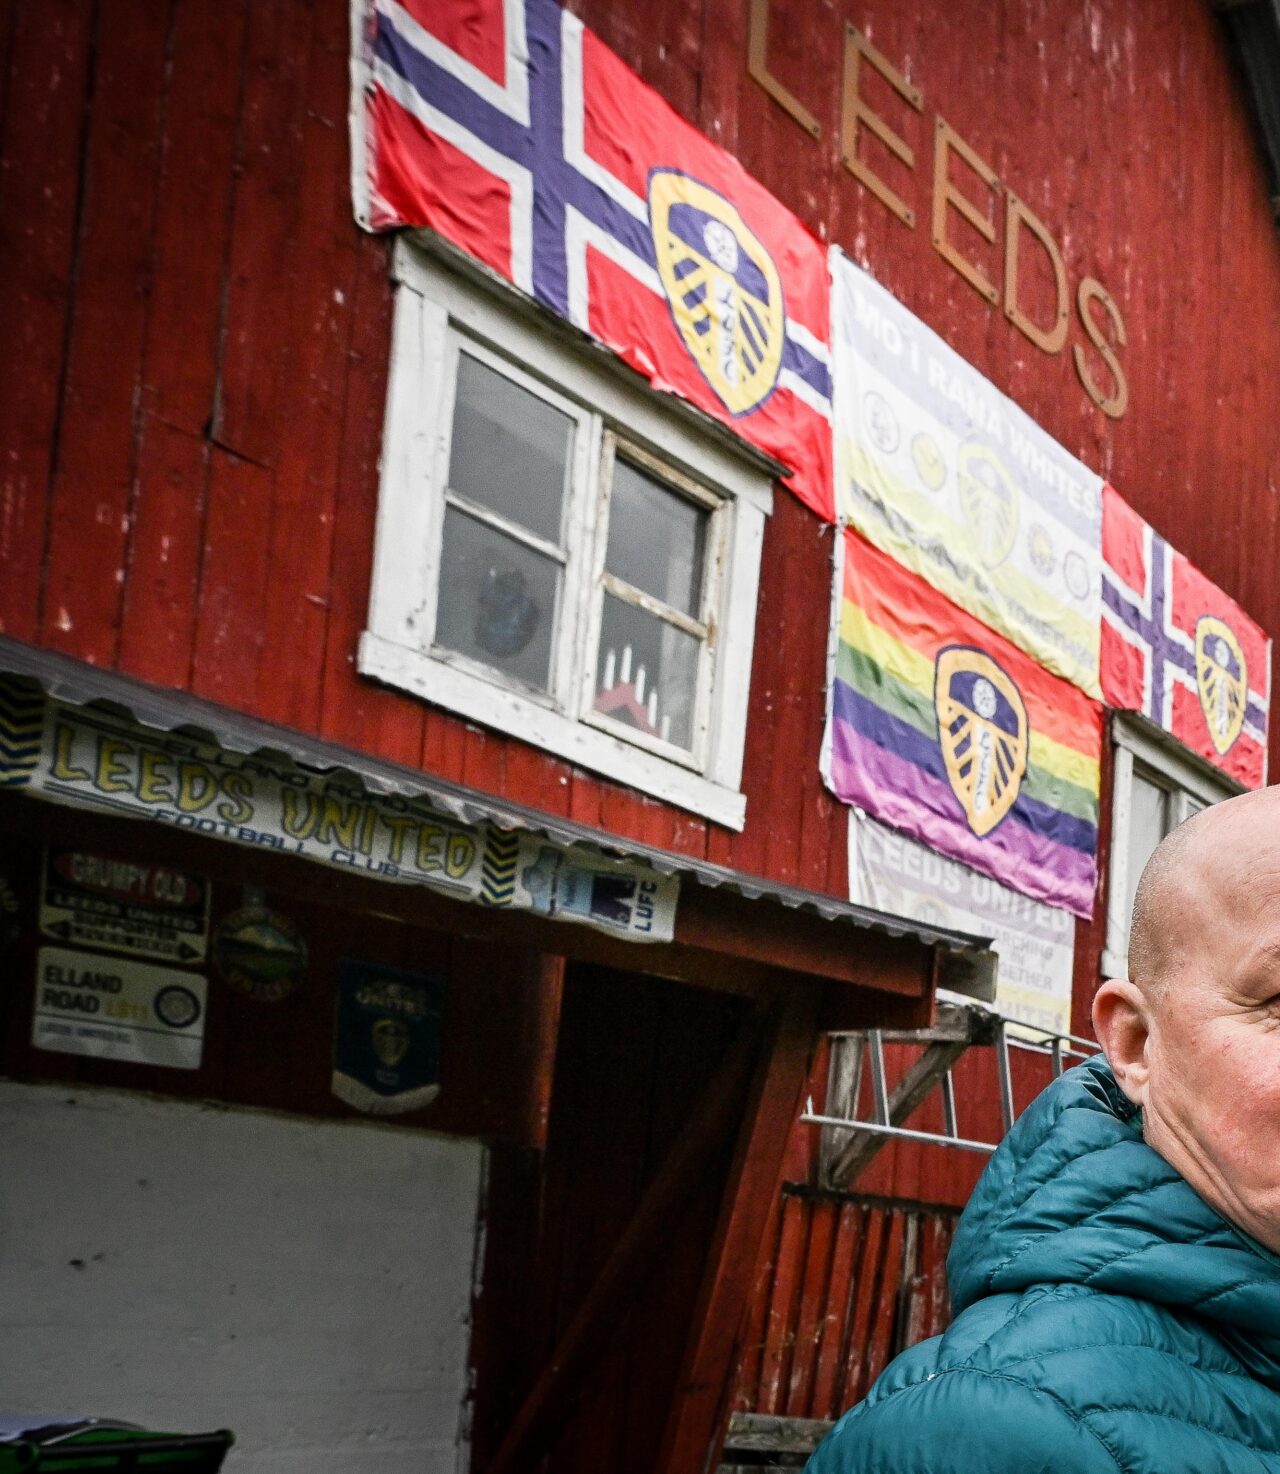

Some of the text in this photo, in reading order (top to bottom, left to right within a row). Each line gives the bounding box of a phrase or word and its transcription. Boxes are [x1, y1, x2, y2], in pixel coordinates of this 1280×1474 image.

[748, 0, 1128, 419] LEEDS
[854, 290, 902, 354] MO
[1008, 429, 1096, 518] WHITES
[50, 720, 478, 879] LEEDS UNITED
[162, 736, 408, 812] ELLAND ROAD
[72, 852, 187, 903] GRUMPY OLD
[151, 806, 402, 879] FOOTBALL CLUB
[635, 881, 658, 932] LUFC
[864, 831, 1070, 932] LEEDS UNITED
[42, 989, 101, 1014] ROAD
[44, 964, 123, 995] ELLAND
[999, 960, 1053, 992] GETHER
